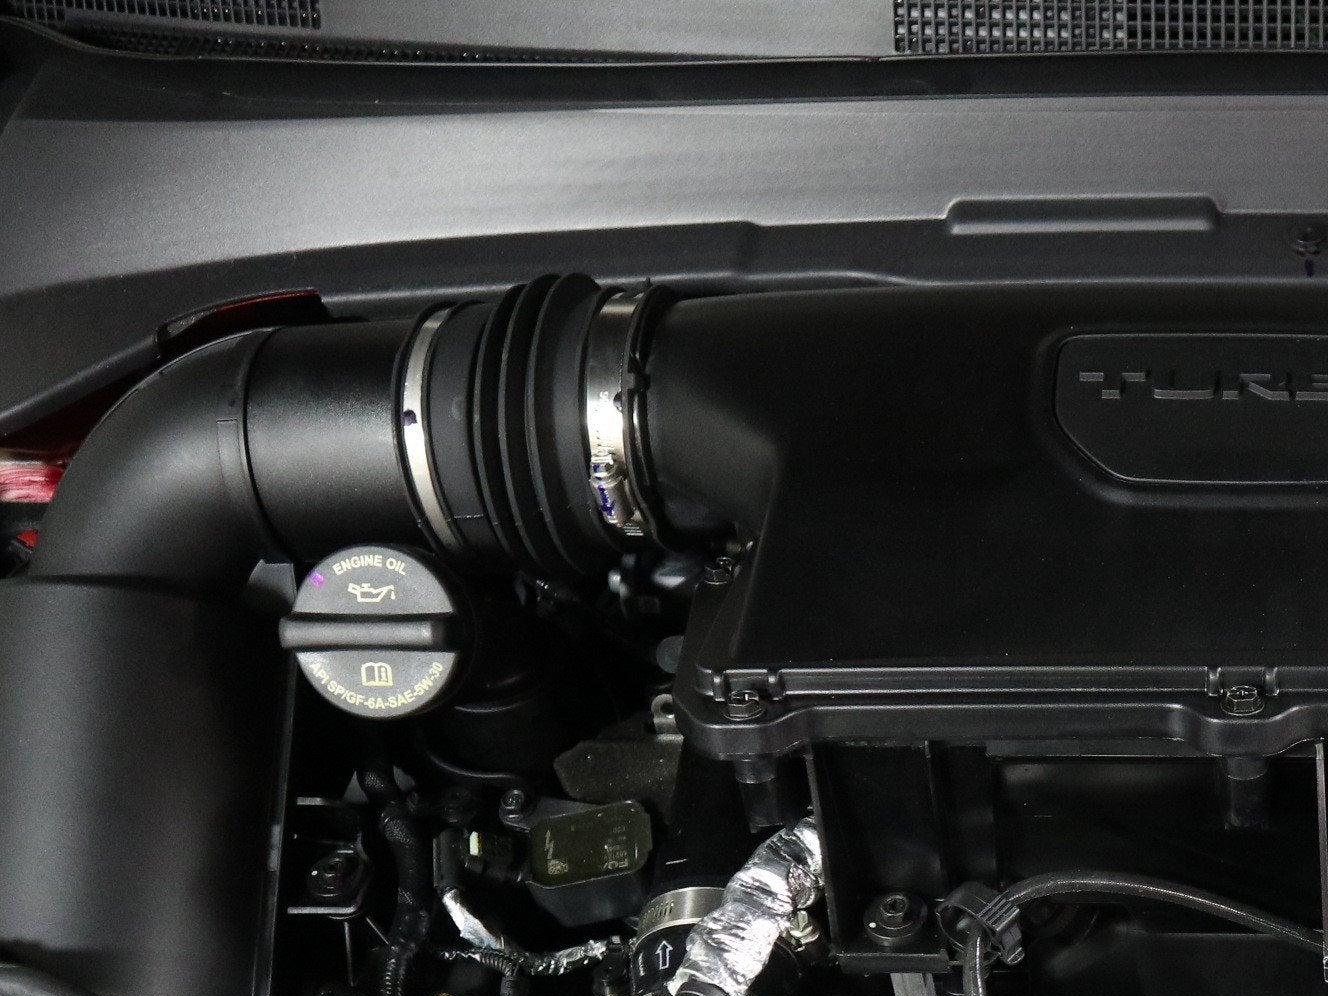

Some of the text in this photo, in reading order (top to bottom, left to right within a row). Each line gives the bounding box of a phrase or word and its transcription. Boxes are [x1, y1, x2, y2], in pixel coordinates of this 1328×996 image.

[332, 554, 407, 575] ENGINE OIL
[309, 662, 330, 684] API
